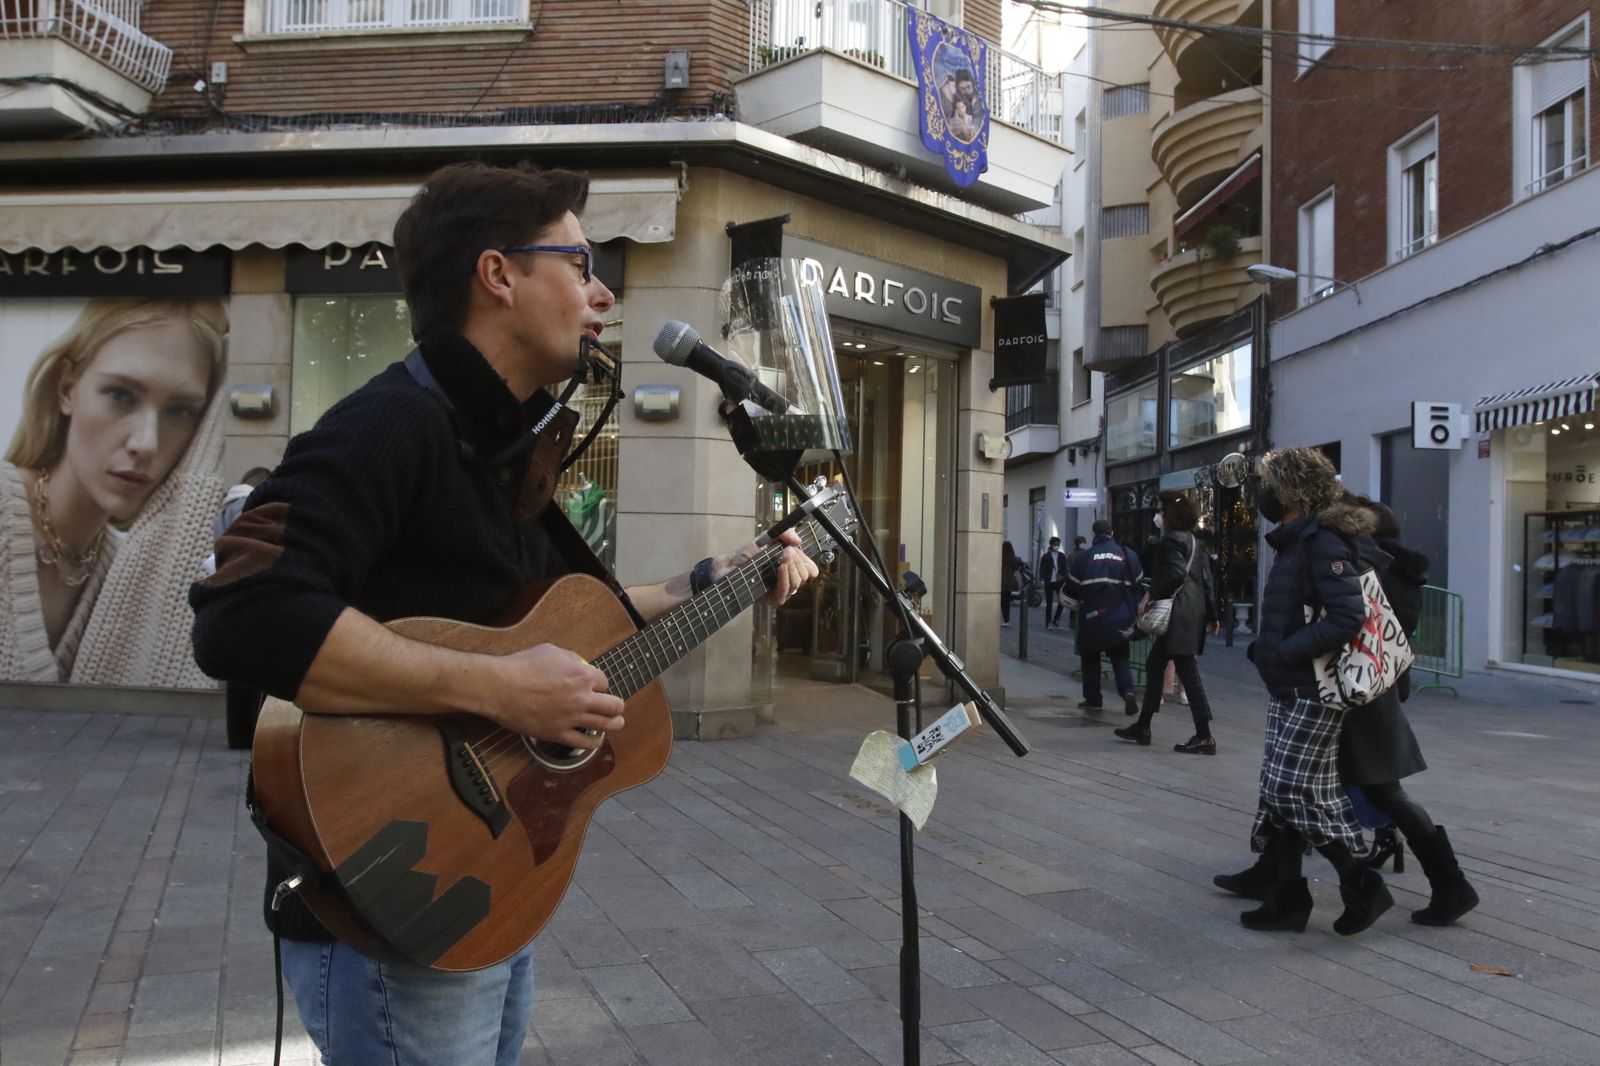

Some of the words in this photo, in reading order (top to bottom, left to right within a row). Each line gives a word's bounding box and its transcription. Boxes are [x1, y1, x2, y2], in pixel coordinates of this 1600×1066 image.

[800, 257, 962, 325] PARFOIS
[998, 334, 1045, 347] PARFOIS
[531, 402, 563, 435] HOHNER
